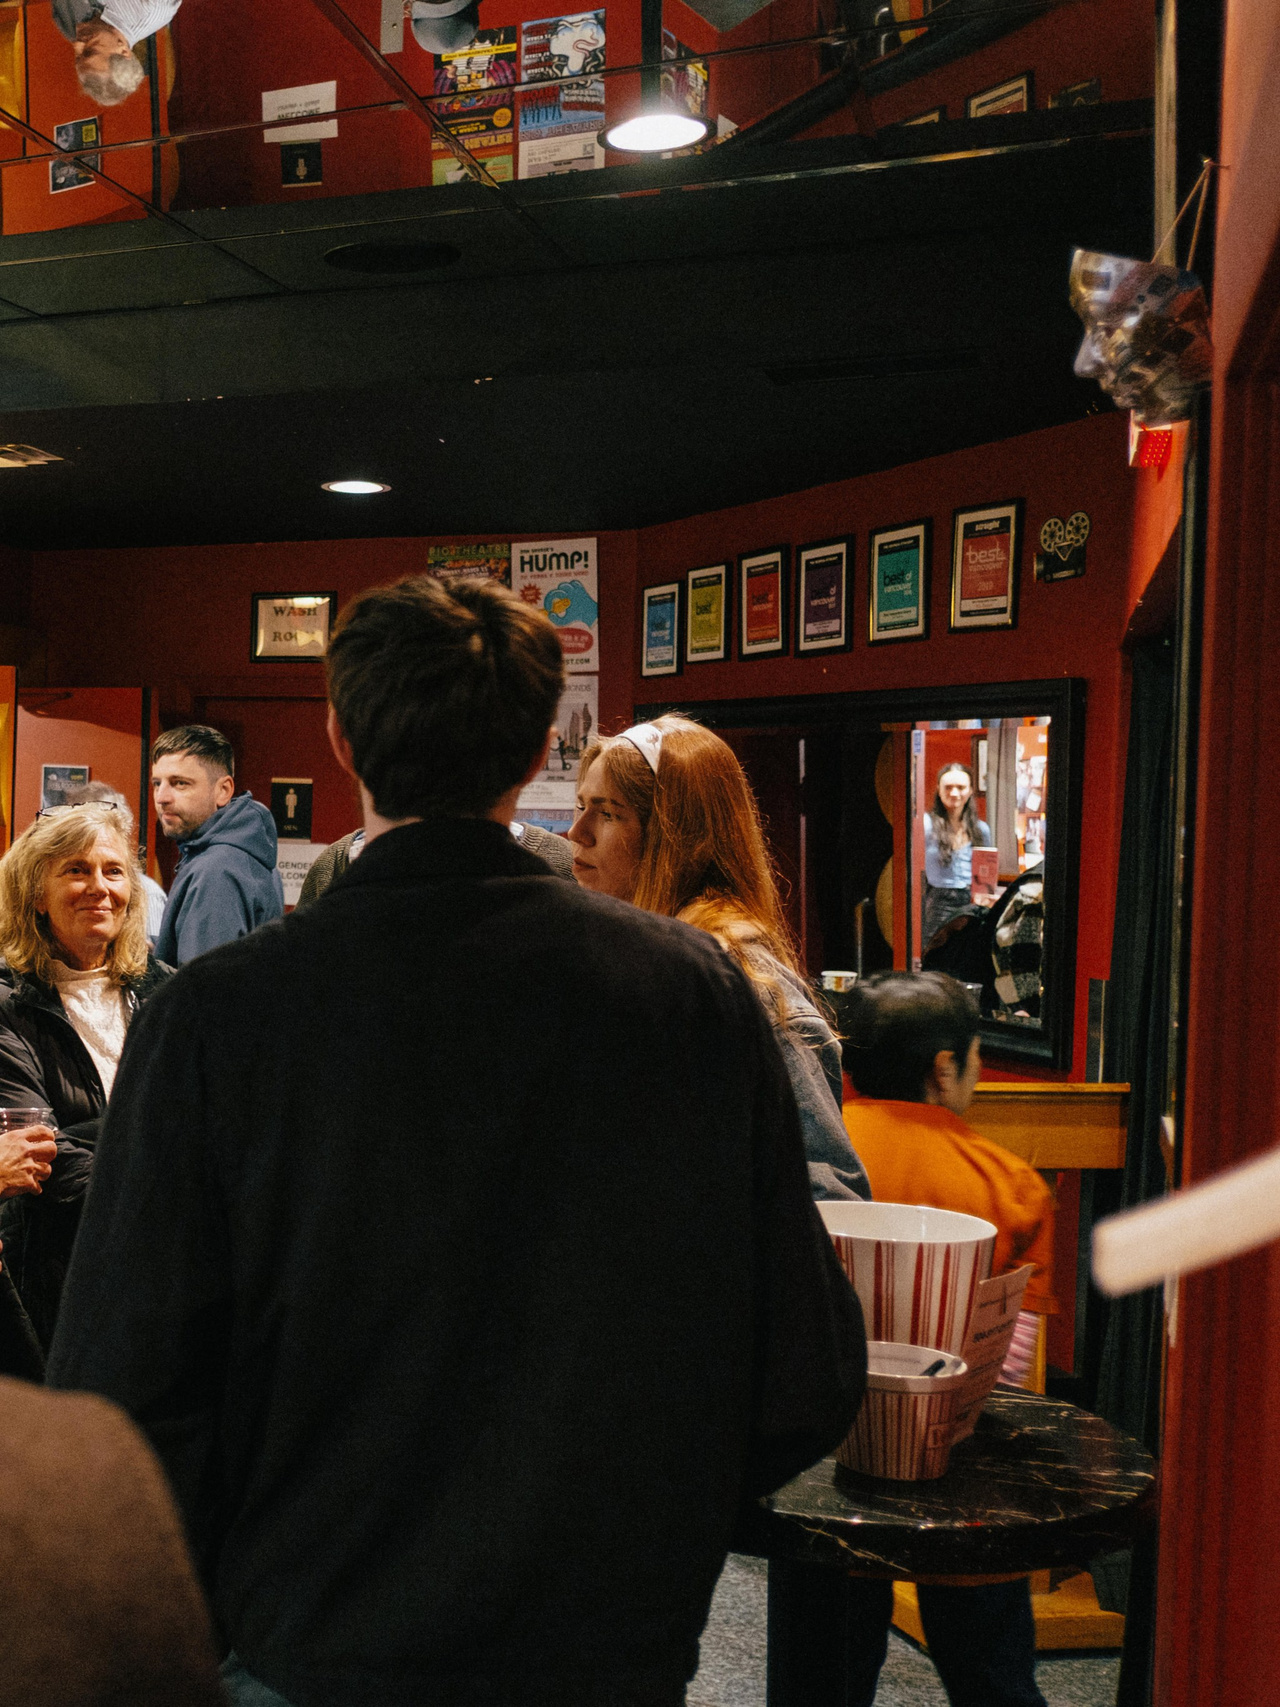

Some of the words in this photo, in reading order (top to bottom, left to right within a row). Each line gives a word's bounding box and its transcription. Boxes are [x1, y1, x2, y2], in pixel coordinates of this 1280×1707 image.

[965, 540, 1003, 564] best
[520, 550, 589, 573] HUMP!
[273, 605, 318, 617] WASH
[282, 873, 310, 881] LCOM
